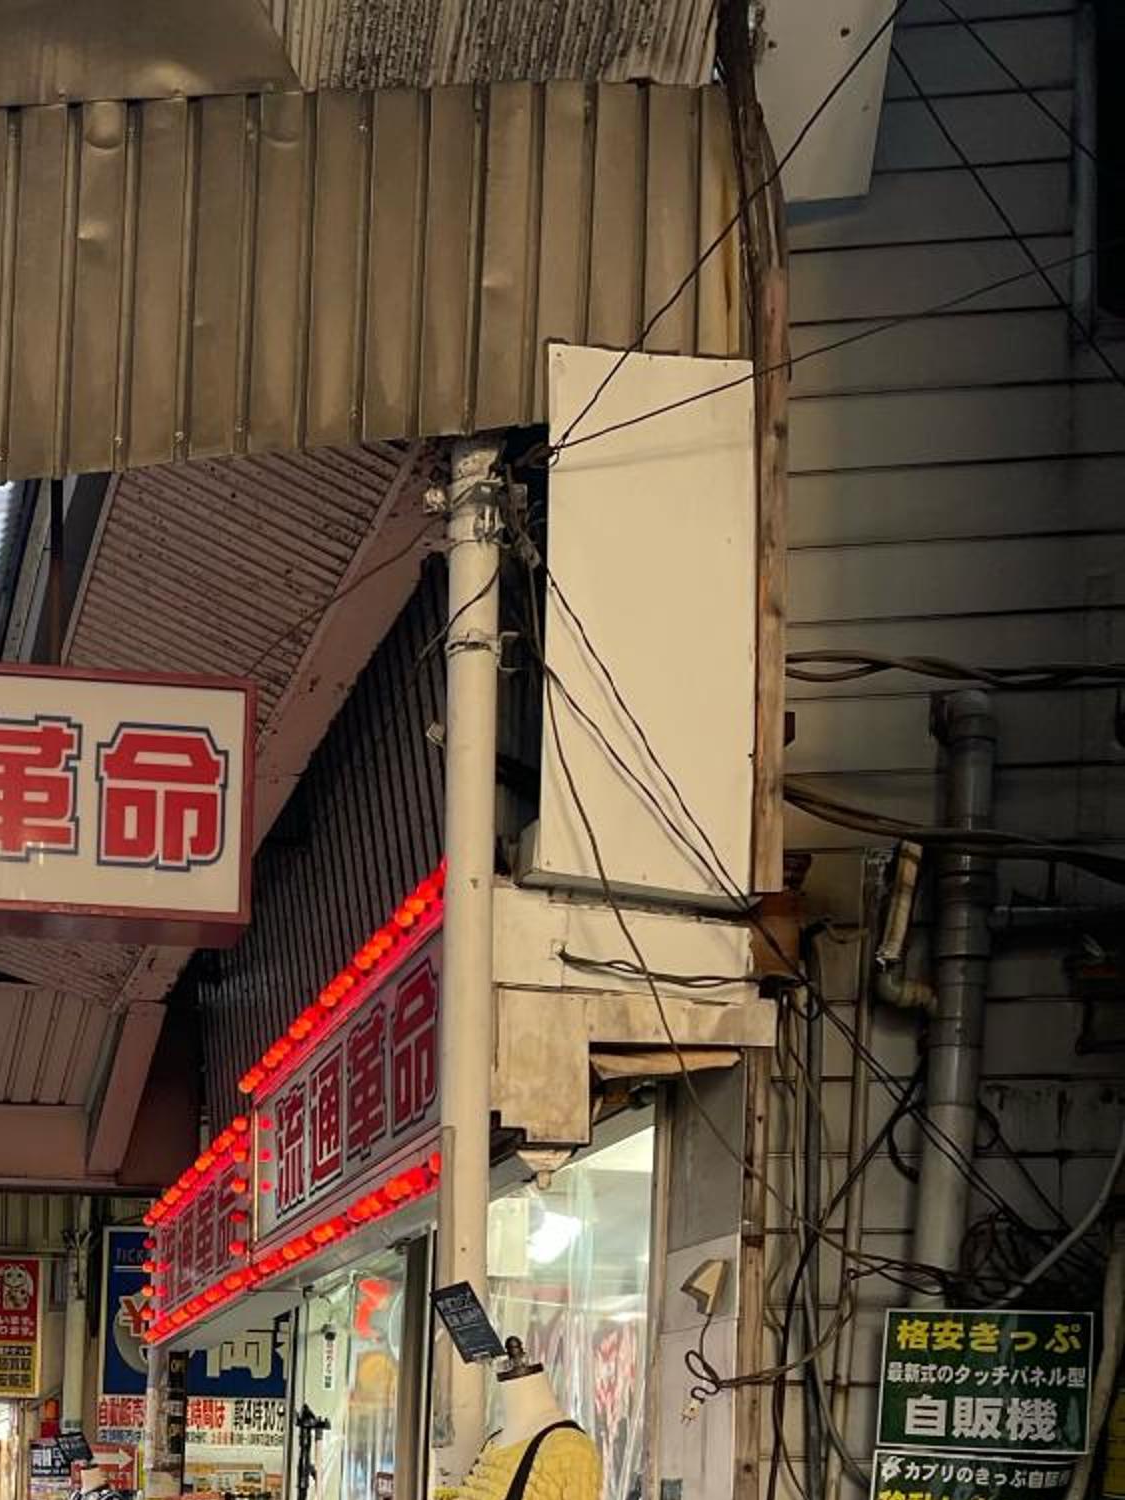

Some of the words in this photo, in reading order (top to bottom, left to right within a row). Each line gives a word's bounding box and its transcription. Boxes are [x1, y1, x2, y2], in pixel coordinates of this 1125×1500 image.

[273, 957, 438, 1215] 流通革命
[896, 1319, 1082, 1353] 格安きっぷ
[887, 1361, 1086, 1388] 最新式のタッチパネル型
[904, 1394, 1058, 1442] 自販機
